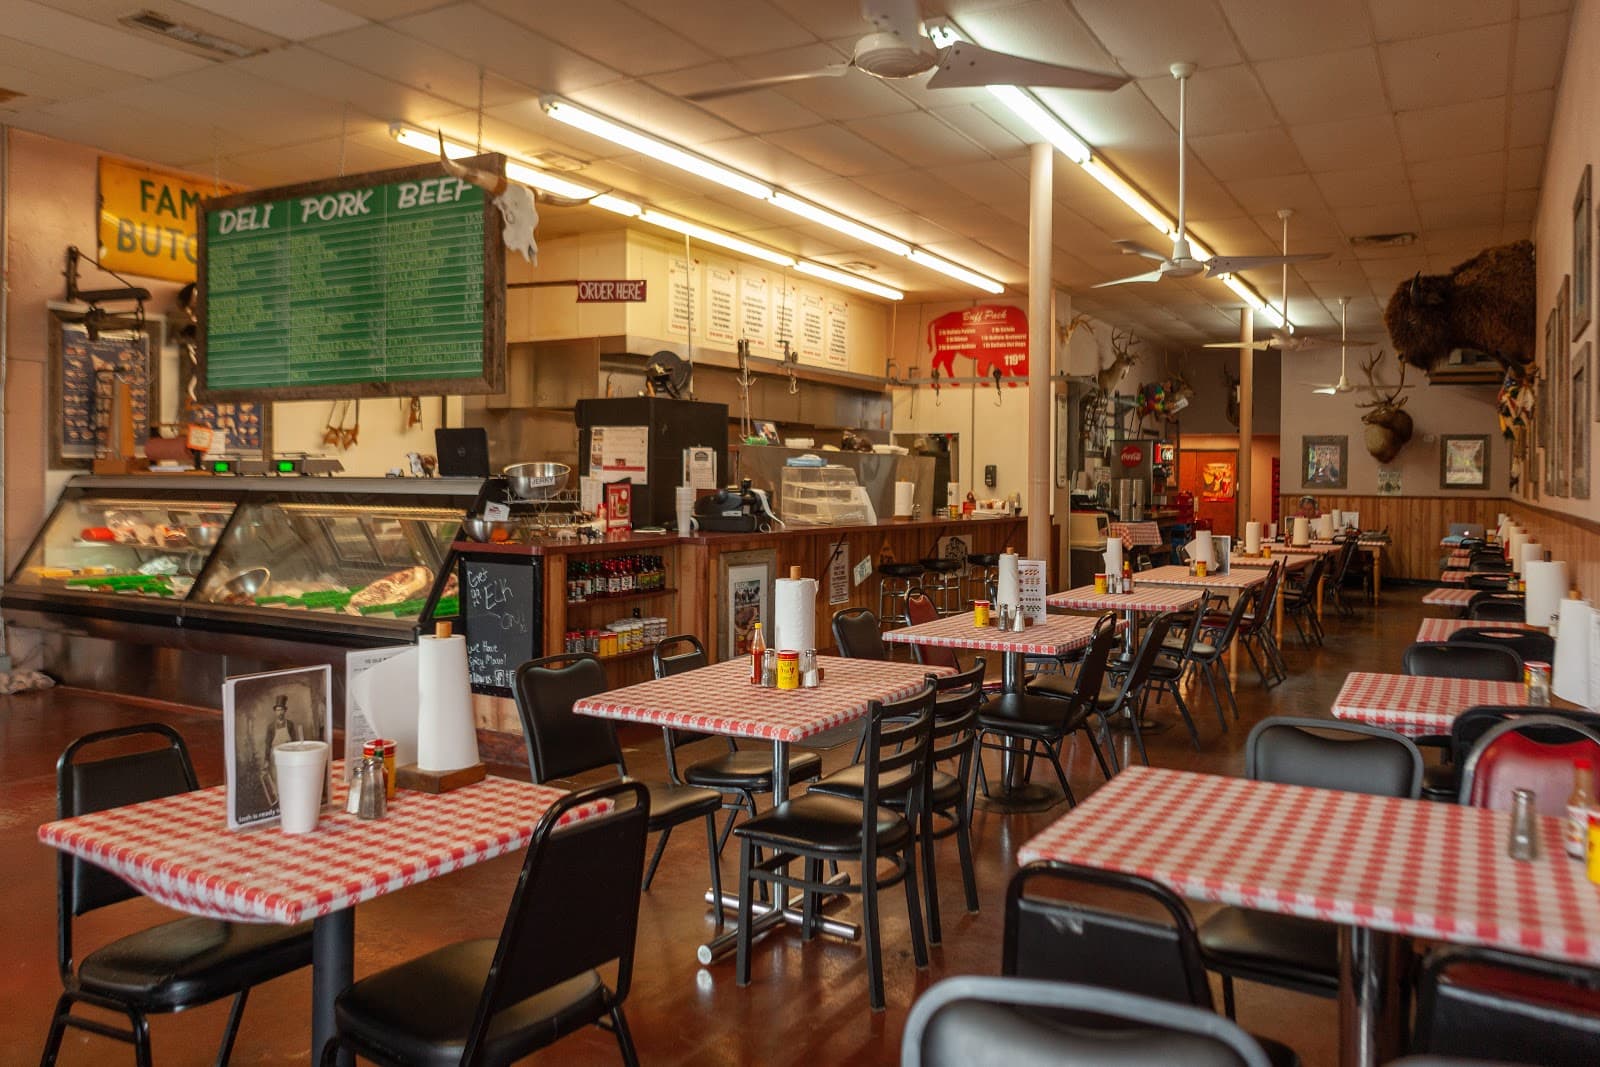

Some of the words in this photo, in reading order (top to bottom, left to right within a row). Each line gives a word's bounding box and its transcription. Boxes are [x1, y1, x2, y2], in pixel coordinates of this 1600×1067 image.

[219, 203, 274, 235] DELI
[300, 189, 374, 223] PORK
[579, 282, 614, 300] ORDER
[616, 282, 642, 300] HERE
